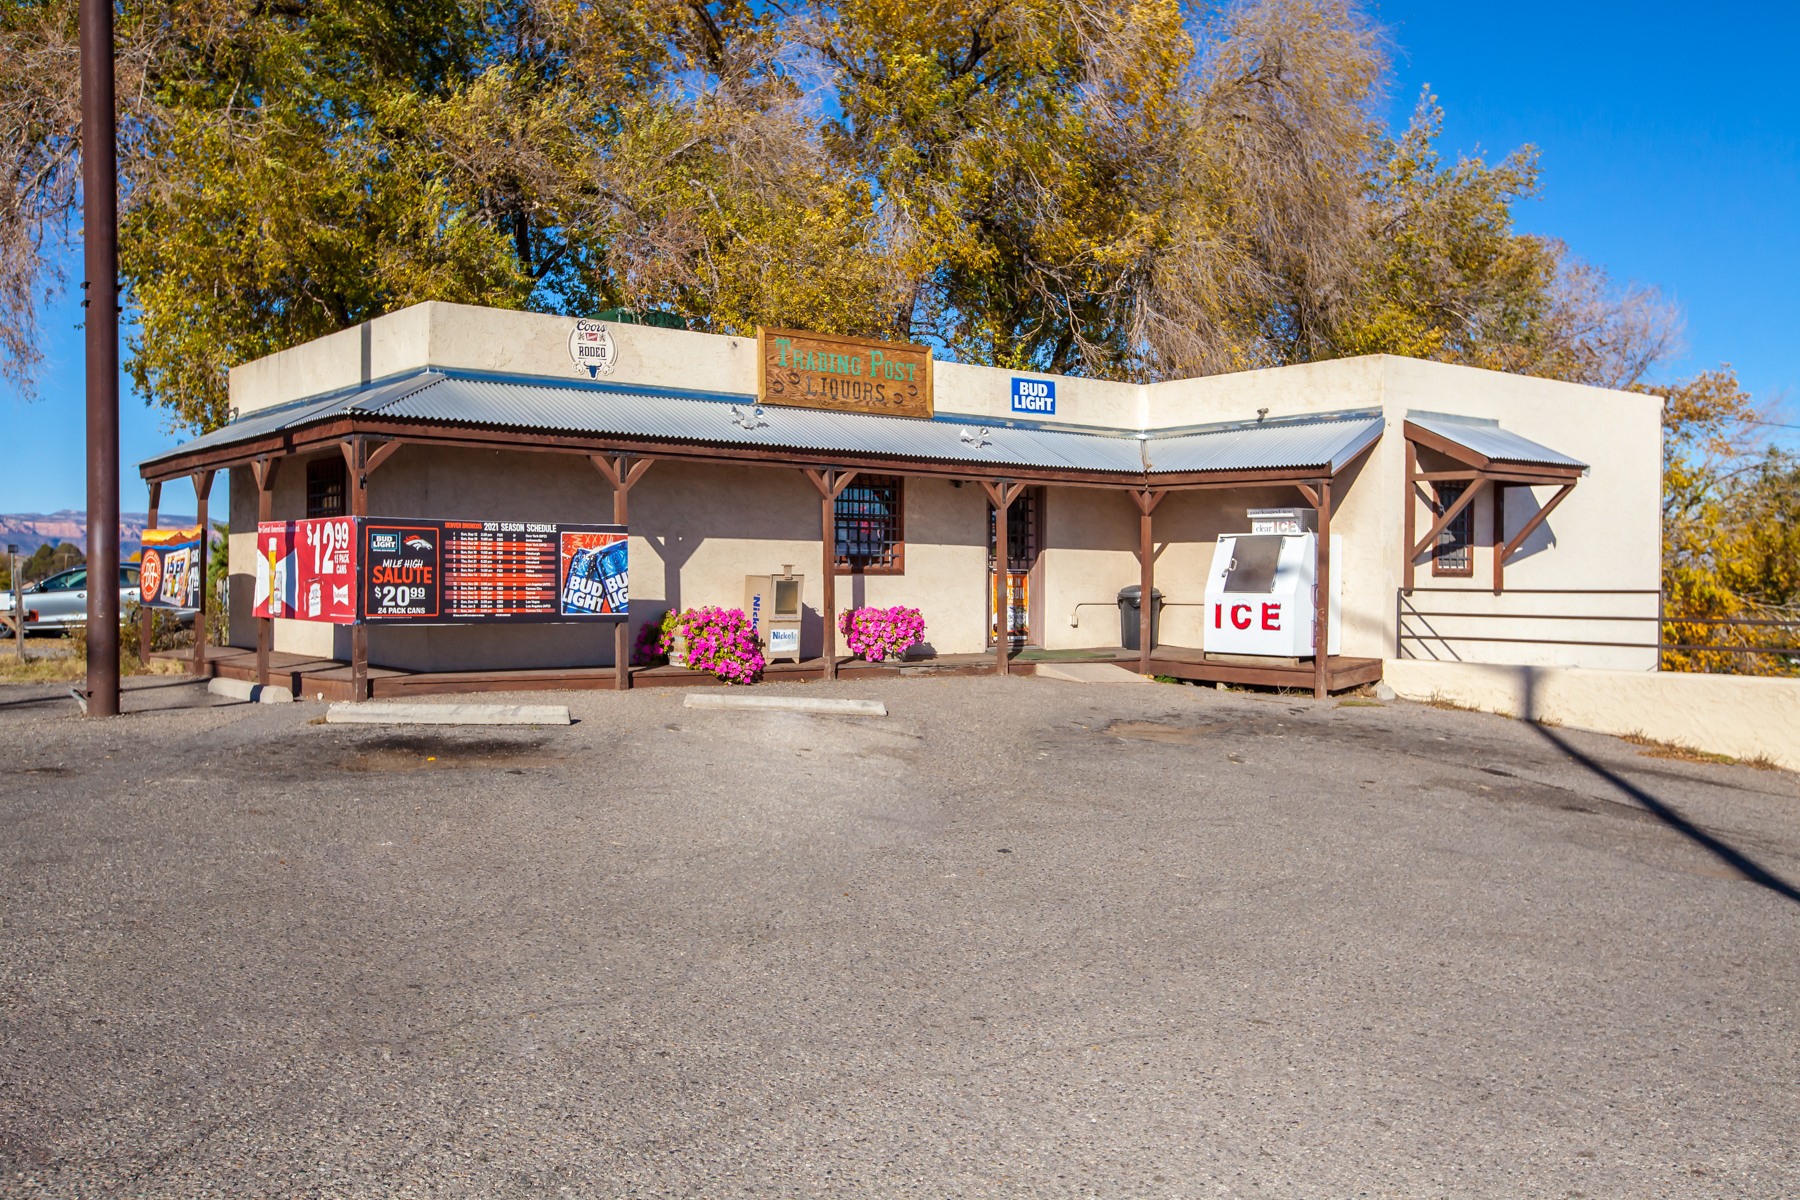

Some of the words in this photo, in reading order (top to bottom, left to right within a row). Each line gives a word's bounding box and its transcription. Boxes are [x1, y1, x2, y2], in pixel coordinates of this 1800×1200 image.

[577, 319, 605, 332] Coors
[579, 346, 605, 357] RODEO
[806, 376, 885, 403] LIQUORS
[1020, 381, 1048, 397] BUD
[1014, 395, 1053, 411] LIGHT
[483, 522, 499, 532] 2021
[500, 523, 524, 532] SEASON
[526, 524, 557, 533] SCHEDULE
[1274, 519, 1296, 533] ICE
[339, 553, 350, 564] PACK
[382, 559, 403, 568] MILE
[404, 559, 423, 568] HIGH
[336, 564, 347, 574] CANS
[372, 565, 433, 584] SALUTE
[569, 575, 603, 597] BUD
[605, 571, 628, 593] BU
[562, 588, 603, 612] LIGHT
[607, 588, 628, 609] LIG
[1215, 599, 1281, 631] ICE
[772, 631, 794, 640] Nickel
